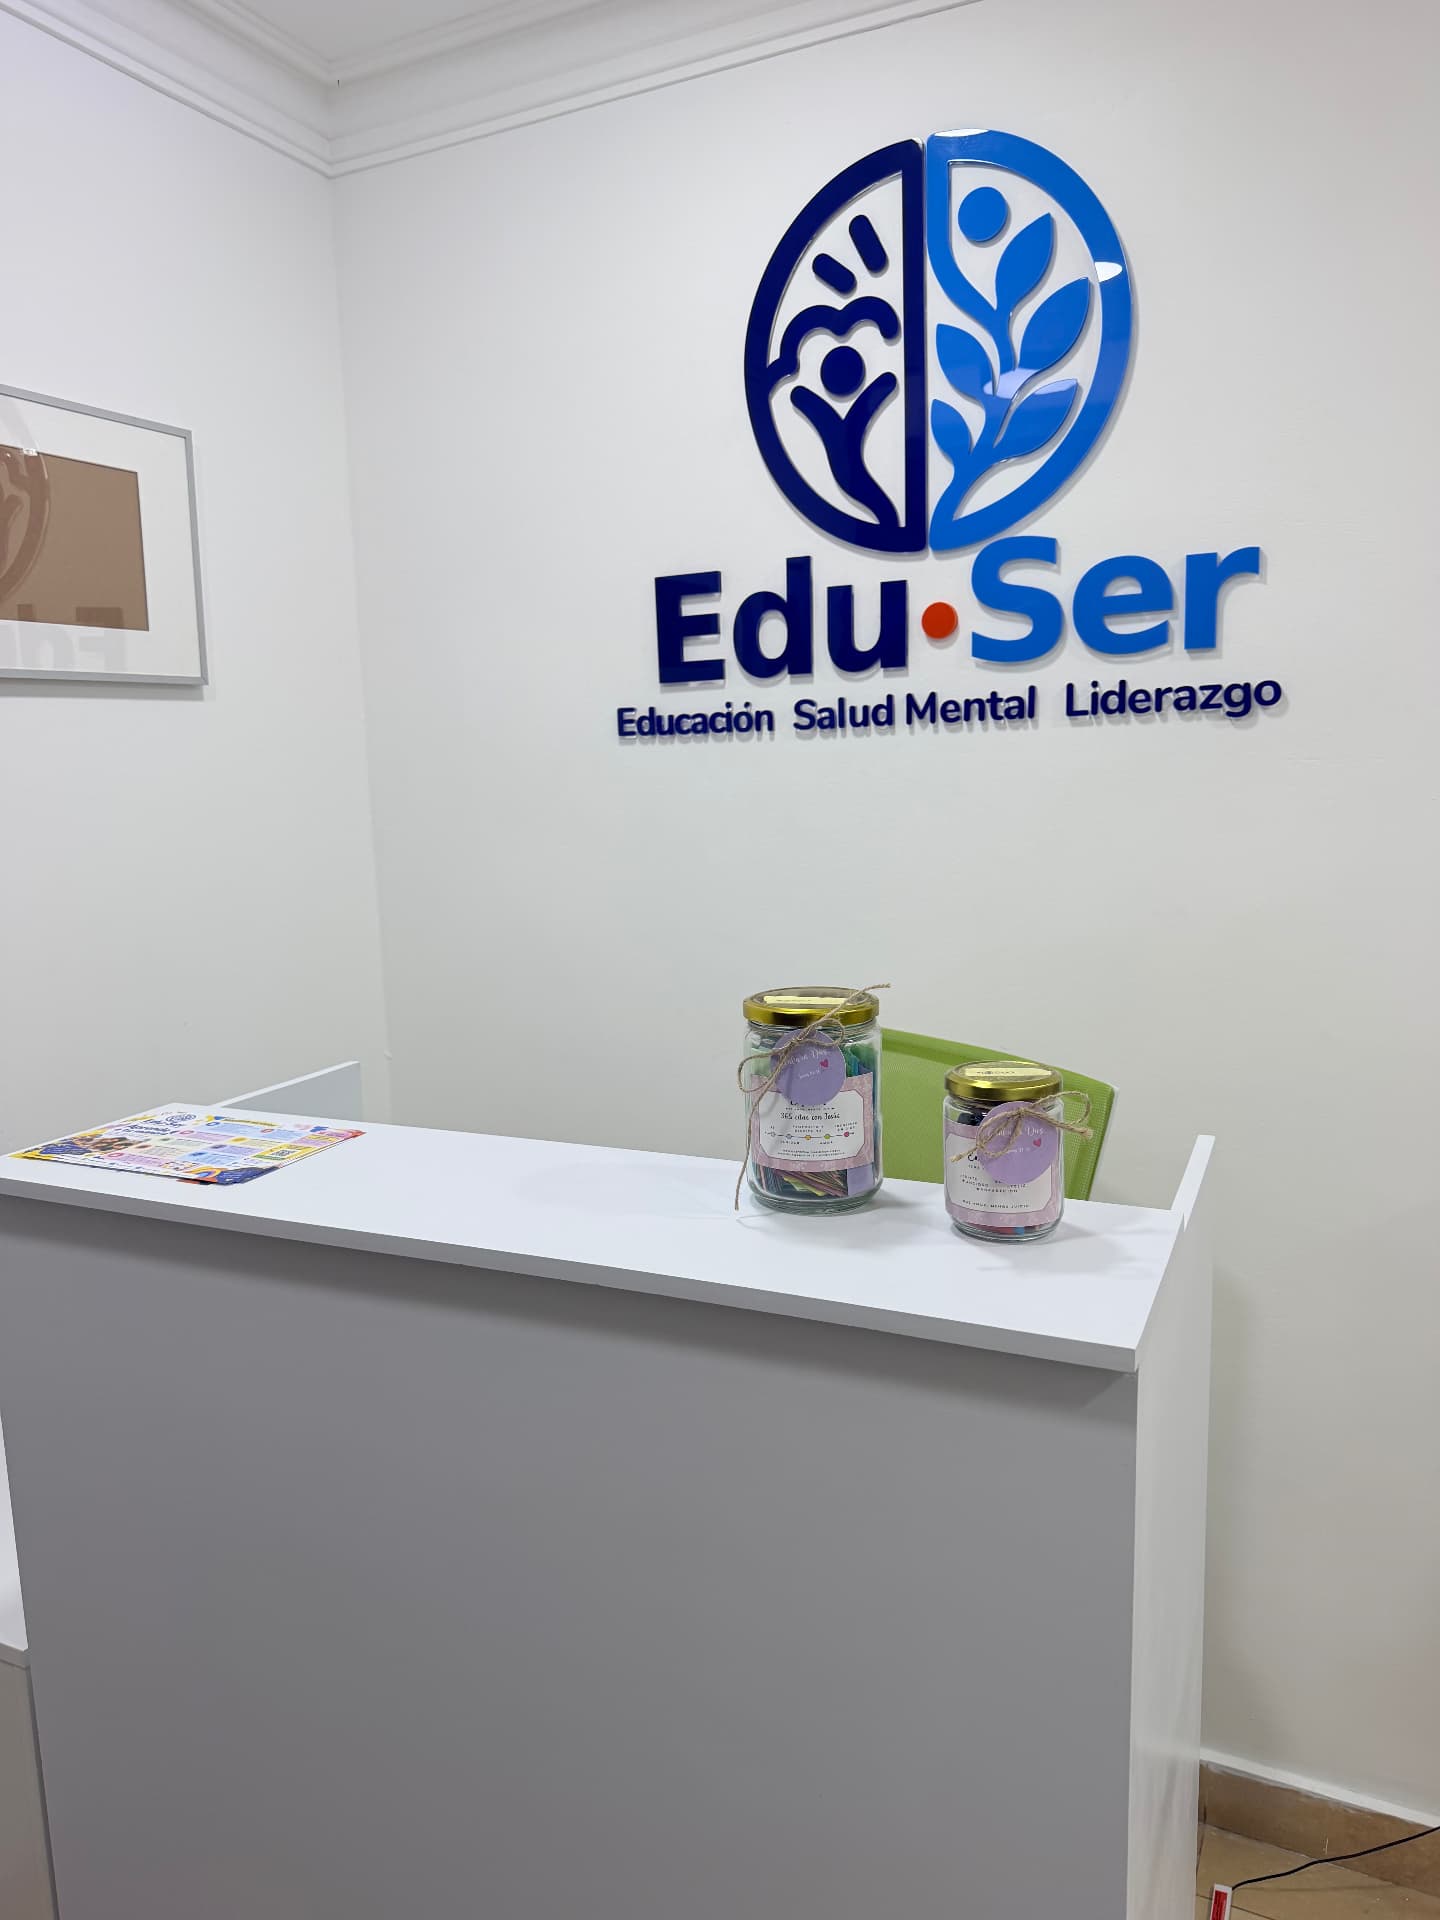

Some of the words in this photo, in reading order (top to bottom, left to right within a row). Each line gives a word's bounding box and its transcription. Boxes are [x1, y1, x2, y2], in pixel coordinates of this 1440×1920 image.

[617, 702, 774, 737] Educación
[793, 694, 894, 730] Salud
[906, 685, 1036, 725] Mental
[1066, 680, 1282, 718] Liderazgo
